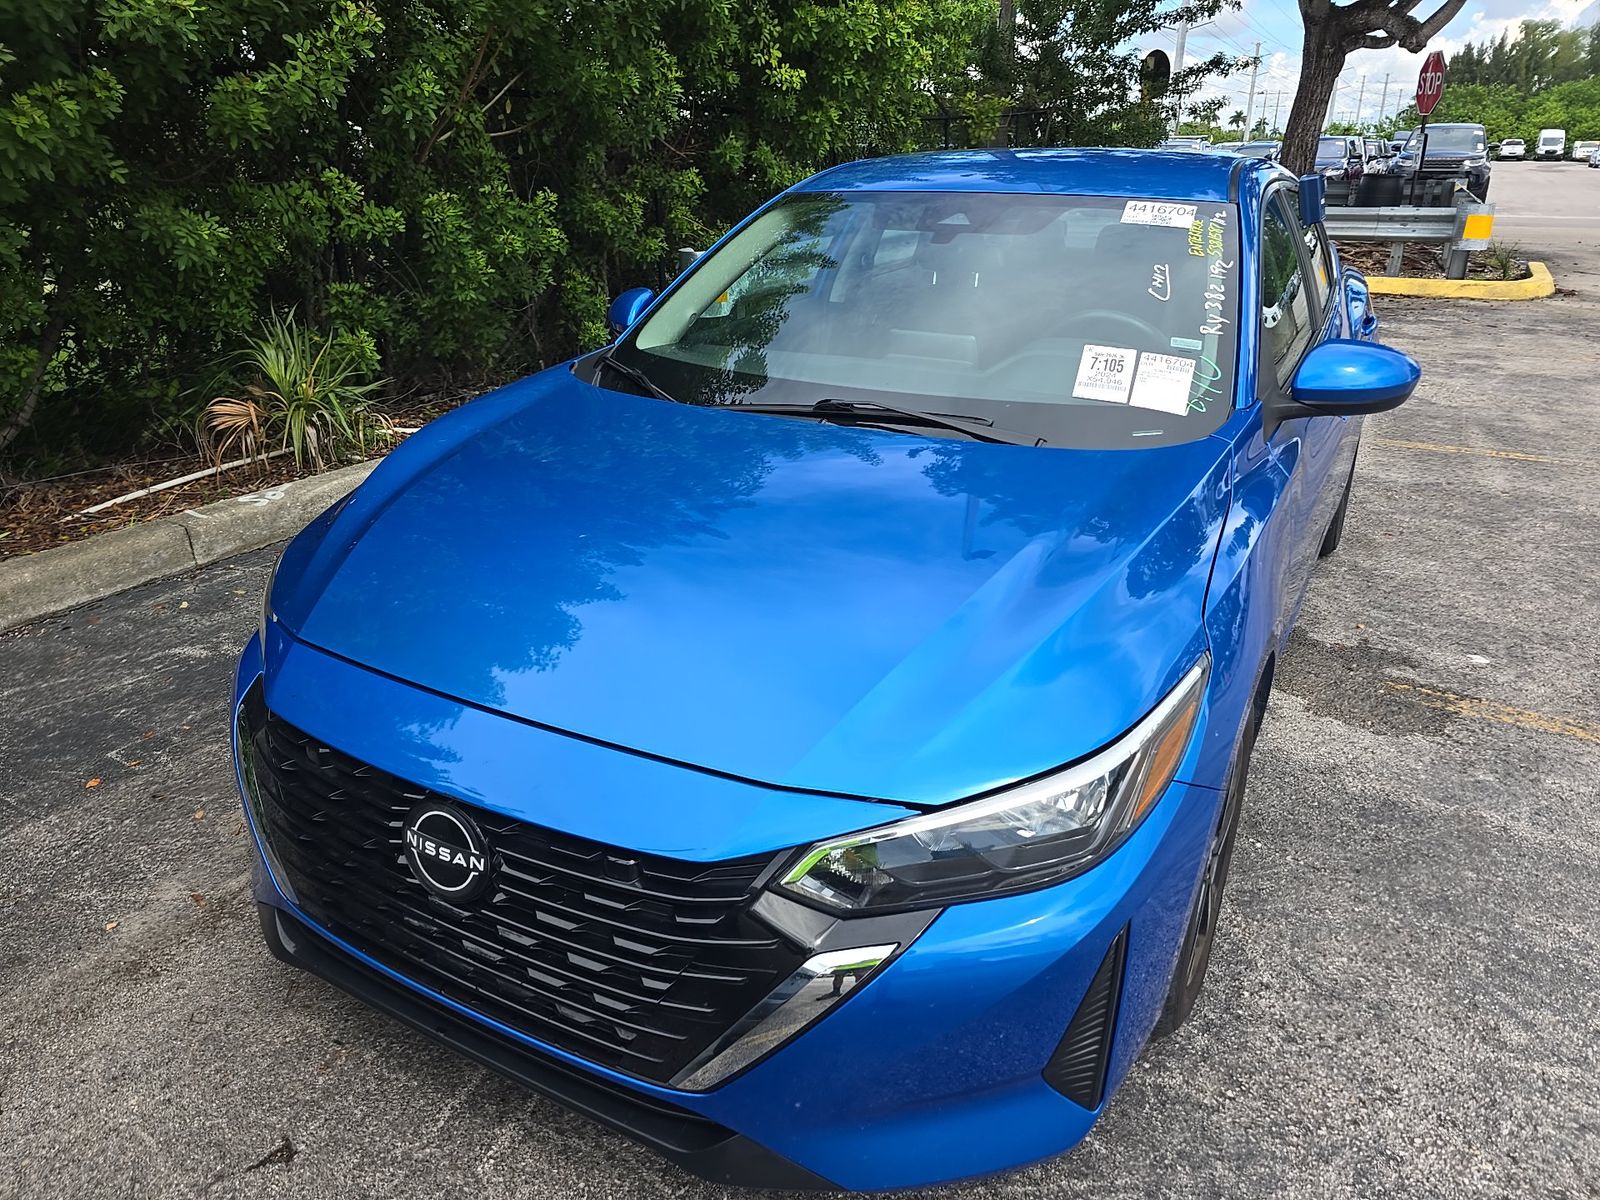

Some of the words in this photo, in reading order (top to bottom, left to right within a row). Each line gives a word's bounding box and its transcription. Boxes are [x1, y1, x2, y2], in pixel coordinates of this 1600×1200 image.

[1418, 72, 1442, 95] STOP
[1129, 203, 1195, 217] 4416704
[1091, 356, 1125, 373] 7:105
[1143, 354, 1194, 368] 4416704
[1095, 371, 1117, 379] 2024
[406, 829, 485, 872] NISSAN
